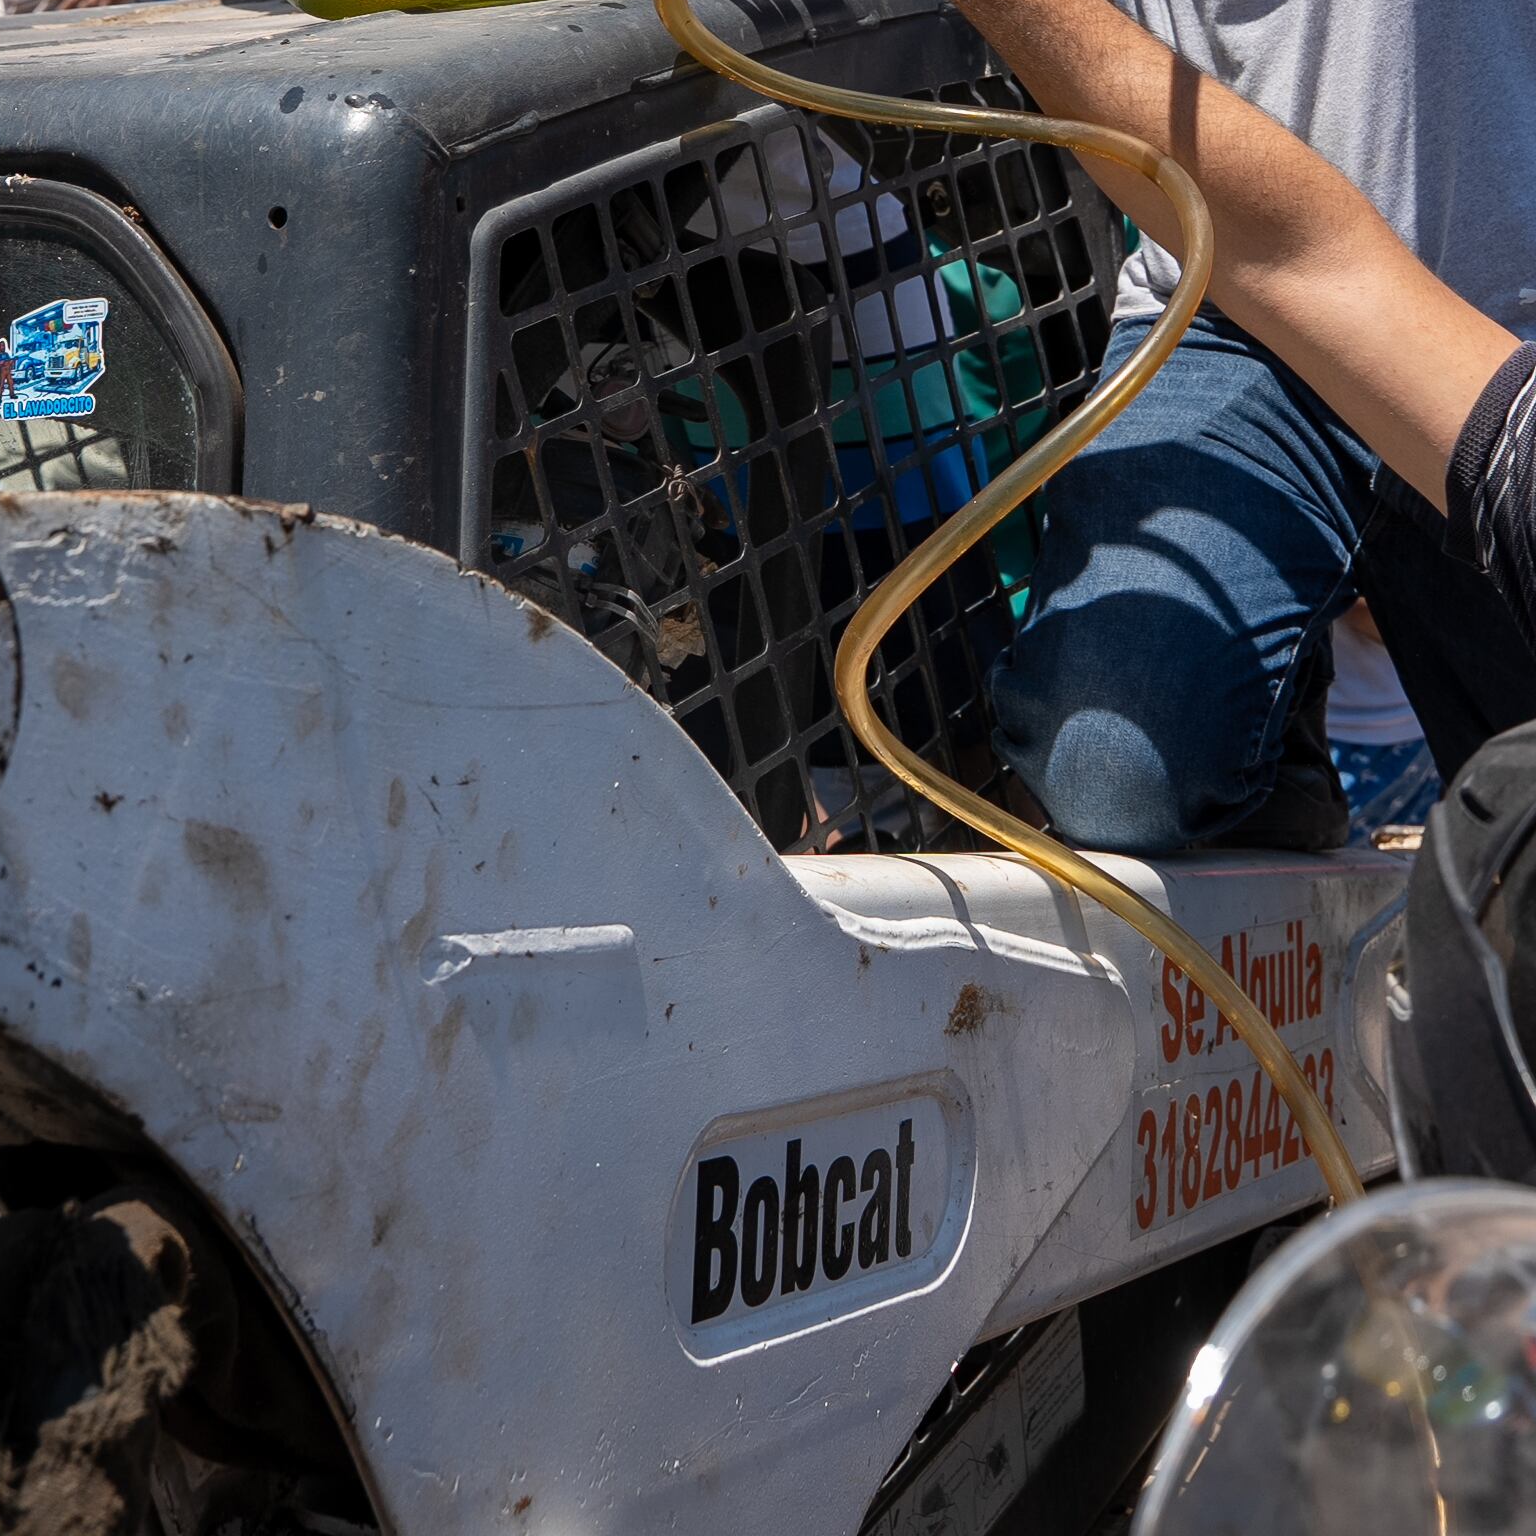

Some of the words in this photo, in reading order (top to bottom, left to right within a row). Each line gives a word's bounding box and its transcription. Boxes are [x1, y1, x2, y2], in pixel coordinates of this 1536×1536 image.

[3, 402, 17, 419] EL
[18, 395, 93, 418] LAVADORCITO
[1161, 954, 1205, 1063] Se
[1216, 920, 1323, 1046] Alquila
[690, 1119, 914, 1324] Bobcat
